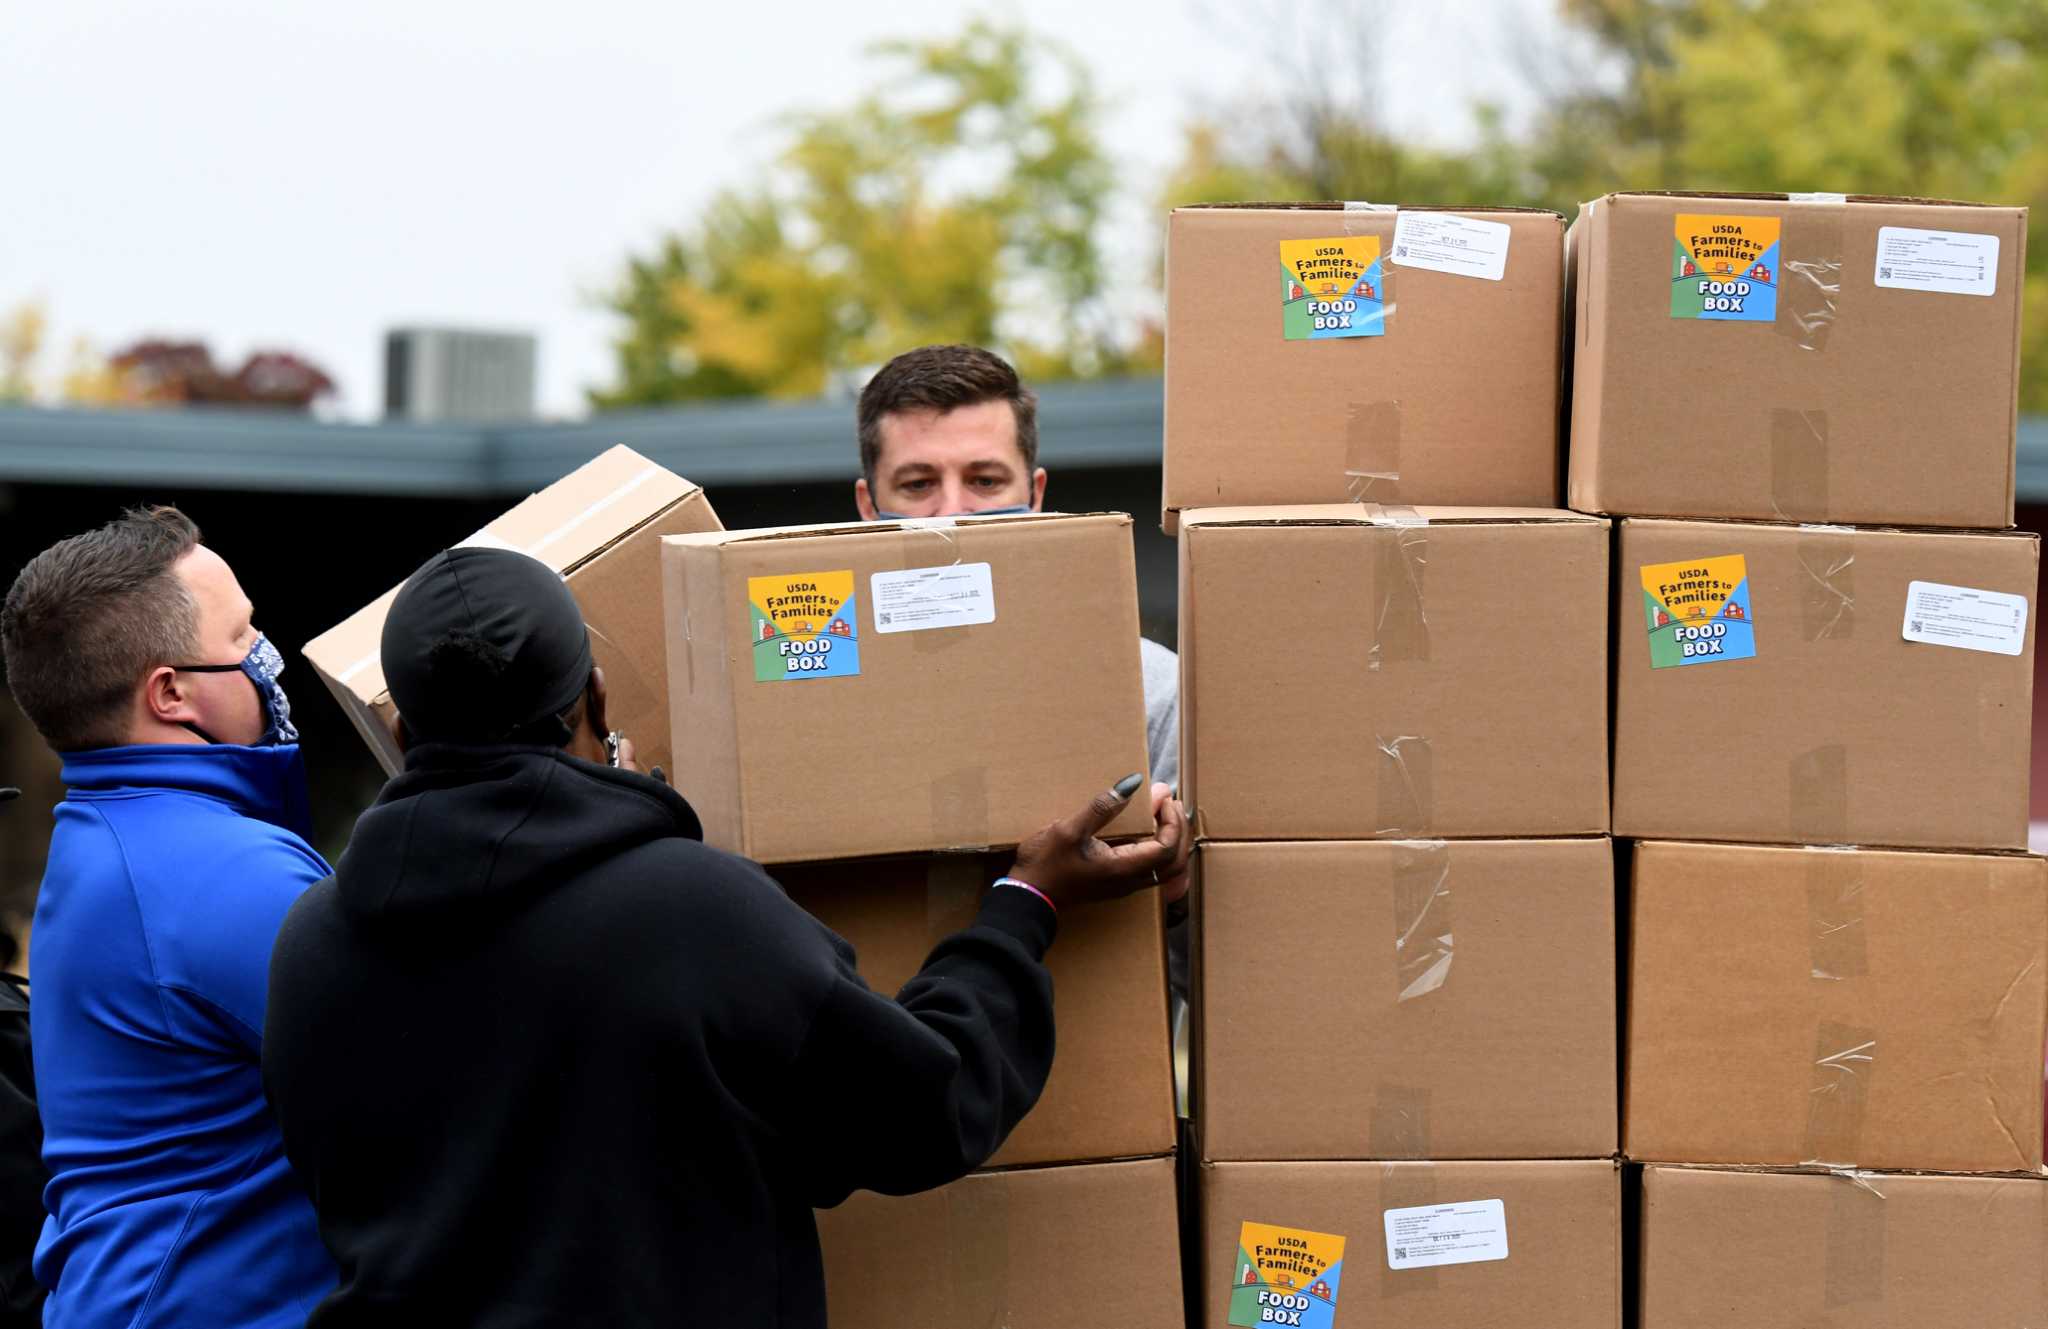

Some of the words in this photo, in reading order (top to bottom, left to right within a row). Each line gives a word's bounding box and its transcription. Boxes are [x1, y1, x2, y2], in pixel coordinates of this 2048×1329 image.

[1712, 225, 1742, 234] USDA
[1691, 235, 1750, 247] Farmers
[1315, 248, 1344, 256] USDA
[1694, 246, 1755, 261] Families
[1296, 258, 1352, 270] Farmers
[1300, 267, 1358, 281] Families
[1699, 281, 1750, 296] FOOD
[1308, 300, 1356, 315] FOOD
[1704, 297, 1744, 312] BOX
[1315, 315, 1352, 330] BOX
[1678, 569, 1708, 579] USDA
[787, 584, 816, 592] USDA
[1659, 579, 1719, 595] Farmers
[767, 594, 826, 608] Farmers
[1664, 590, 1726, 607] Families
[771, 605, 833, 620] Families
[1675, 623, 1727, 642] FOOD
[779, 638, 831, 656] FOOD
[1683, 639, 1723, 657] BOX
[787, 656, 827, 672] BOX
[1278, 1237, 1307, 1249] USDA
[1256, 1245, 1314, 1263] Farmers
[1317, 1259, 1326, 1267] to
[1257, 1257, 1318, 1277] Families
[1258, 1290, 1310, 1311] FOOD
[1262, 1307, 1301, 1326] BOX
